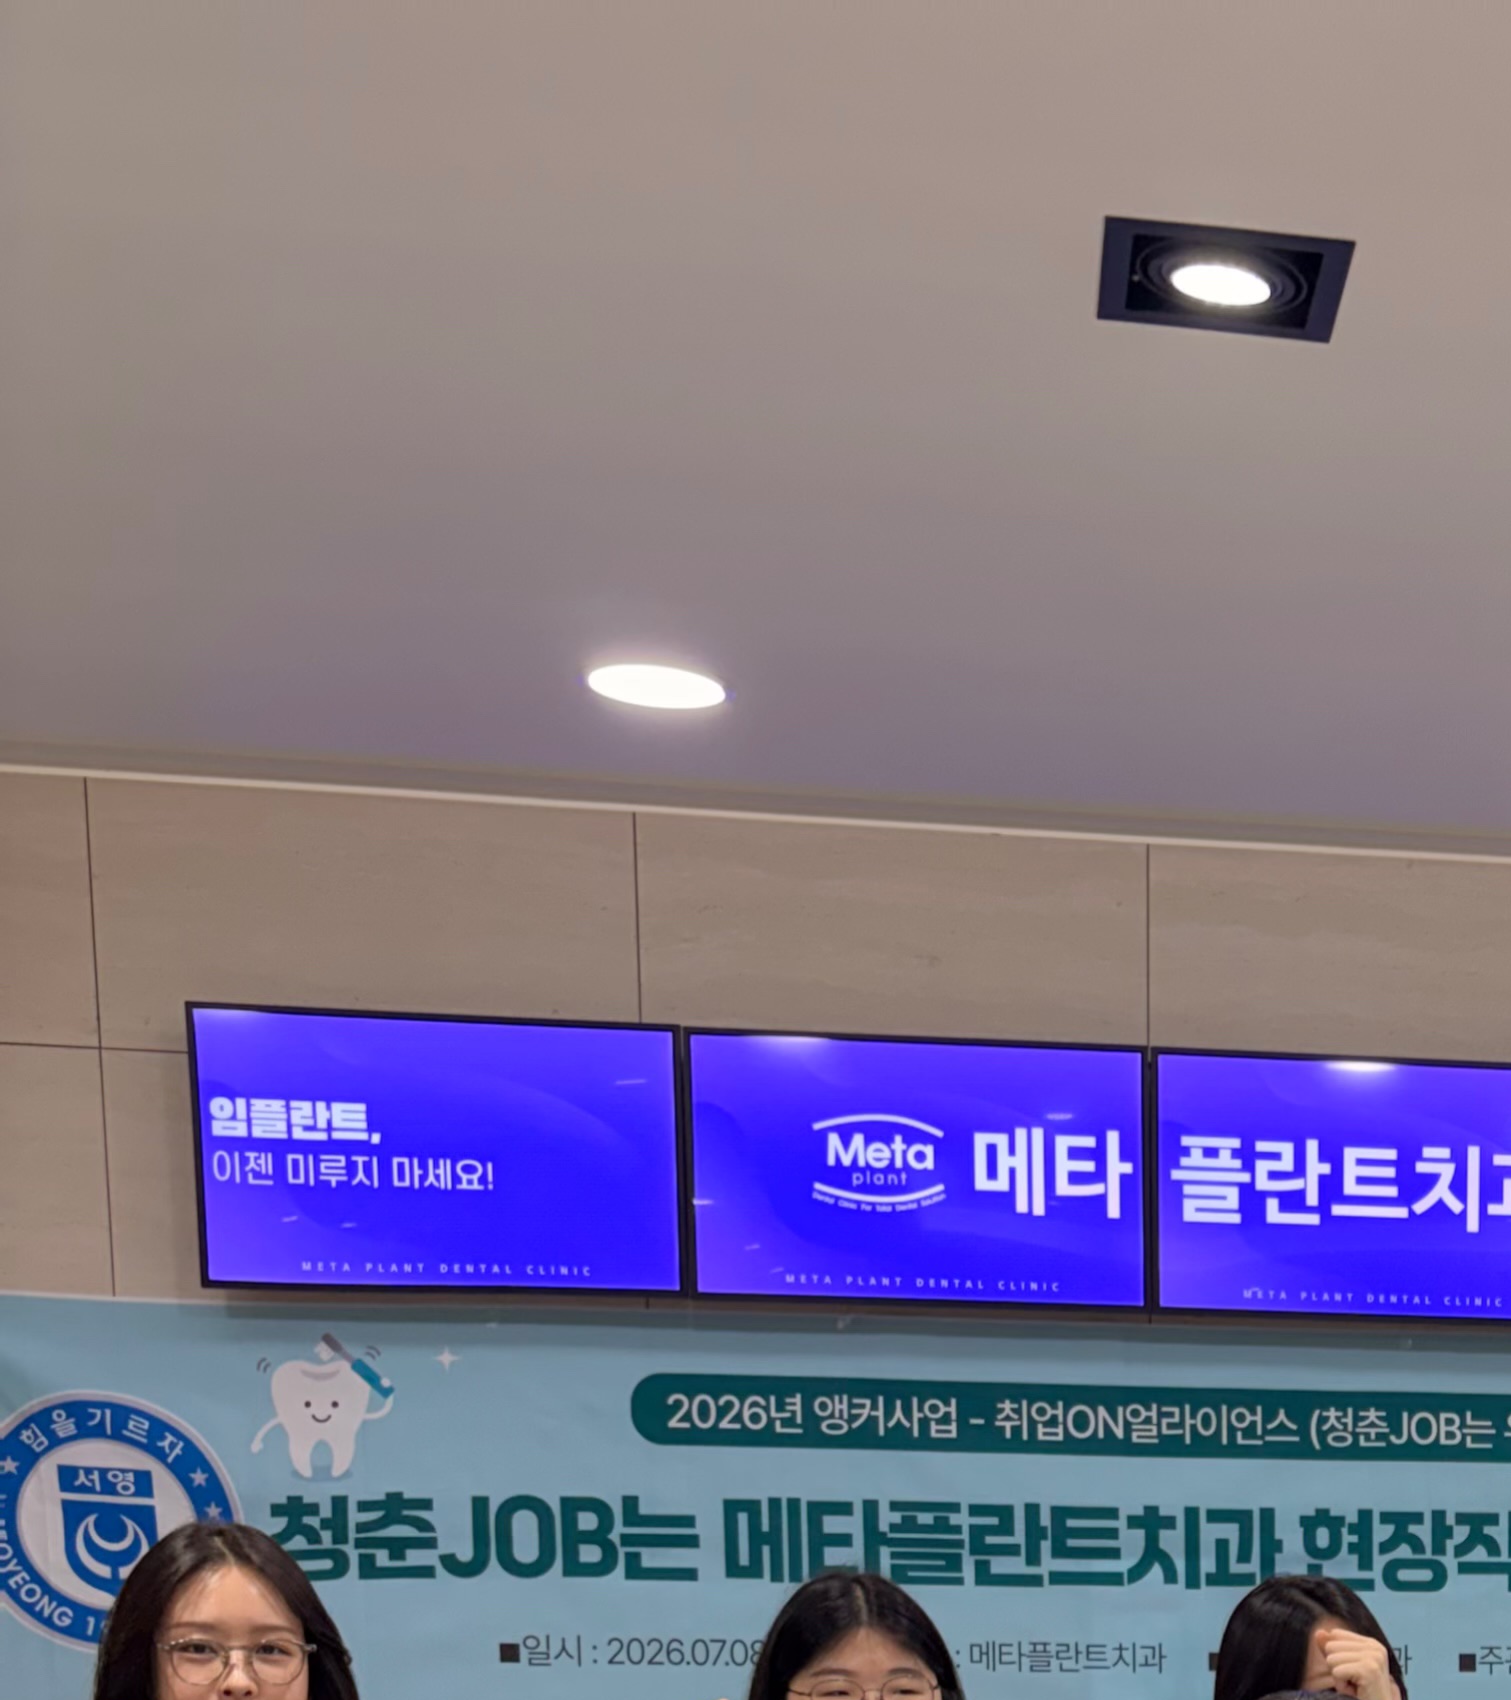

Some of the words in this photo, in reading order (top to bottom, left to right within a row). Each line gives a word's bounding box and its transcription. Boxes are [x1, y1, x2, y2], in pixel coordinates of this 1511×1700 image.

[209, 1096, 381, 1144] 임플란트,
[827, 1132, 934, 1170] Meta
[212, 1150, 275, 1186] 이젠
[287, 1153, 379, 1189] 미루지
[392, 1156, 494, 1191] 마세요!
[852, 1170, 907, 1187] plant
[973, 1127, 1133, 1219] 메타
[302, 1261, 351, 1273] META
[365, 1262, 425, 1274] PLANT
[440, 1263, 513, 1275] DENTAL
[526, 1264, 592, 1277] CLINIC
[785, 1273, 832, 1285] META
[846, 1275, 902, 1287] PLANT
[916, 1277, 984, 1290] DENTAL
[998, 1280, 1061, 1292] CLINIC
[1243, 1288, 1287, 1300] META
[1300, 1290, 1353, 1302] PLANT
[1366, 1292, 1432, 1305] DENTAL
[1443, 1295, 1503, 1307] CLINIC
[666, 1393, 803, 1434] 2026년
[814, 1394, 957, 1439] 앵커사업
[994, 1399, 1298, 1445] 취업ON얼라이언스
[1309, 1407, 1496, 1450] (청춘JOB는
[74, 1468, 135, 1495] 서영
[270, 1492, 700, 1582] 청춘JOB는
[723, 1497, 1283, 1590] 메타플란트치과
[0, 1519, 73, 1627] OYEONG
[522, 1634, 582, 1667] 일시
[606, 1637, 765, 1667] 2026.07.08
[969, 1641, 1167, 1674] 메타플란트치과
